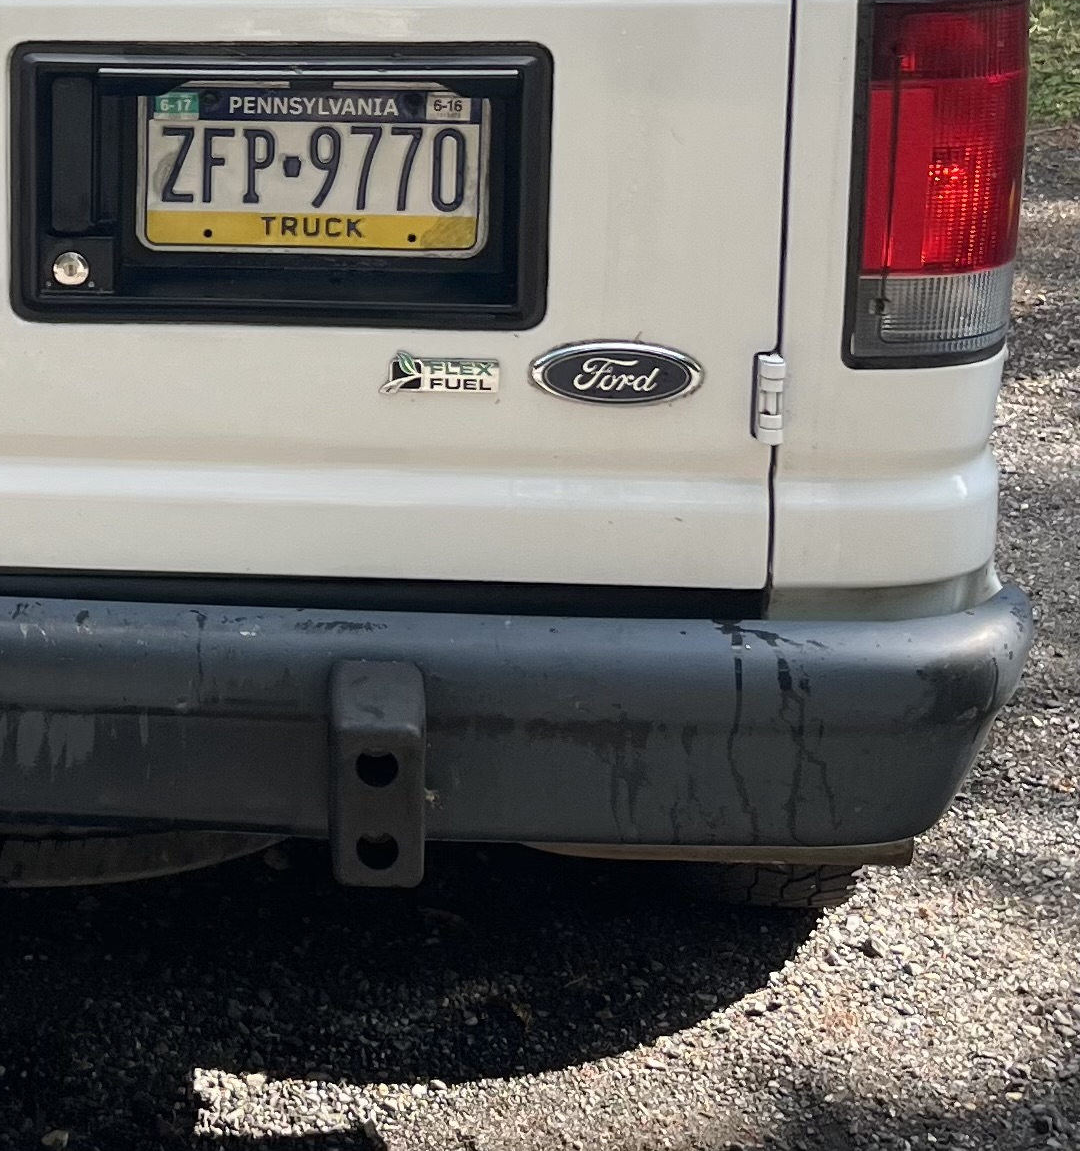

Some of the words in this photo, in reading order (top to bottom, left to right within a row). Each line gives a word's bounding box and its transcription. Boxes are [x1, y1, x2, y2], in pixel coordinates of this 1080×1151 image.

[160, 99, 192, 112] 6-17
[228, 95, 400, 117] PENNSYLVANIA
[433, 99, 463, 112] 6-16
[260, 215, 366, 239] TRUCK
[428, 360, 494, 377] FLEX
[572, 356, 660, 393] Ford
[428, 377, 492, 391] FUEL
